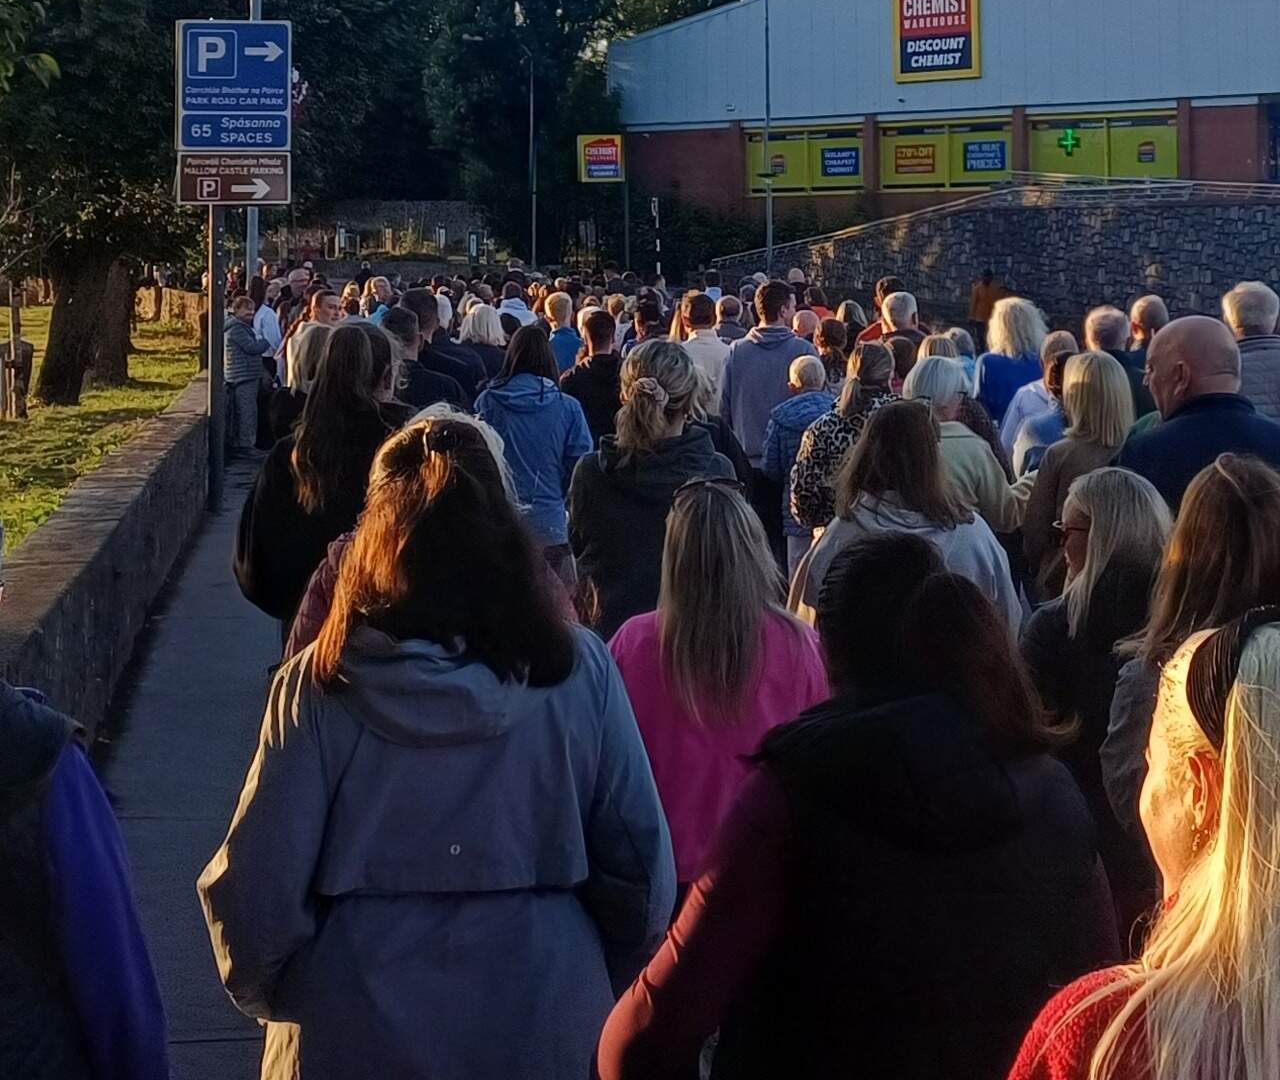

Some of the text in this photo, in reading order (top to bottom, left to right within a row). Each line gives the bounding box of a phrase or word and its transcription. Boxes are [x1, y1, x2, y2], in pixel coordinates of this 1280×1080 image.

[903, 14, 966, 29] WAREHOUSE
[907, 37, 966, 53] DISCOUNT
[197, 36, 226, 73] P
[911, 53, 961, 67] CHEMIST
[185, 97, 284, 105] PARK ROAD CAR PARK
[191, 117, 281, 137] 65 Spásanna
[220, 132, 272, 143] SPACES
[183, 167, 217, 175] MALLOW
[219, 167, 249, 175] CASTLE
[202, 180, 216, 198] P
